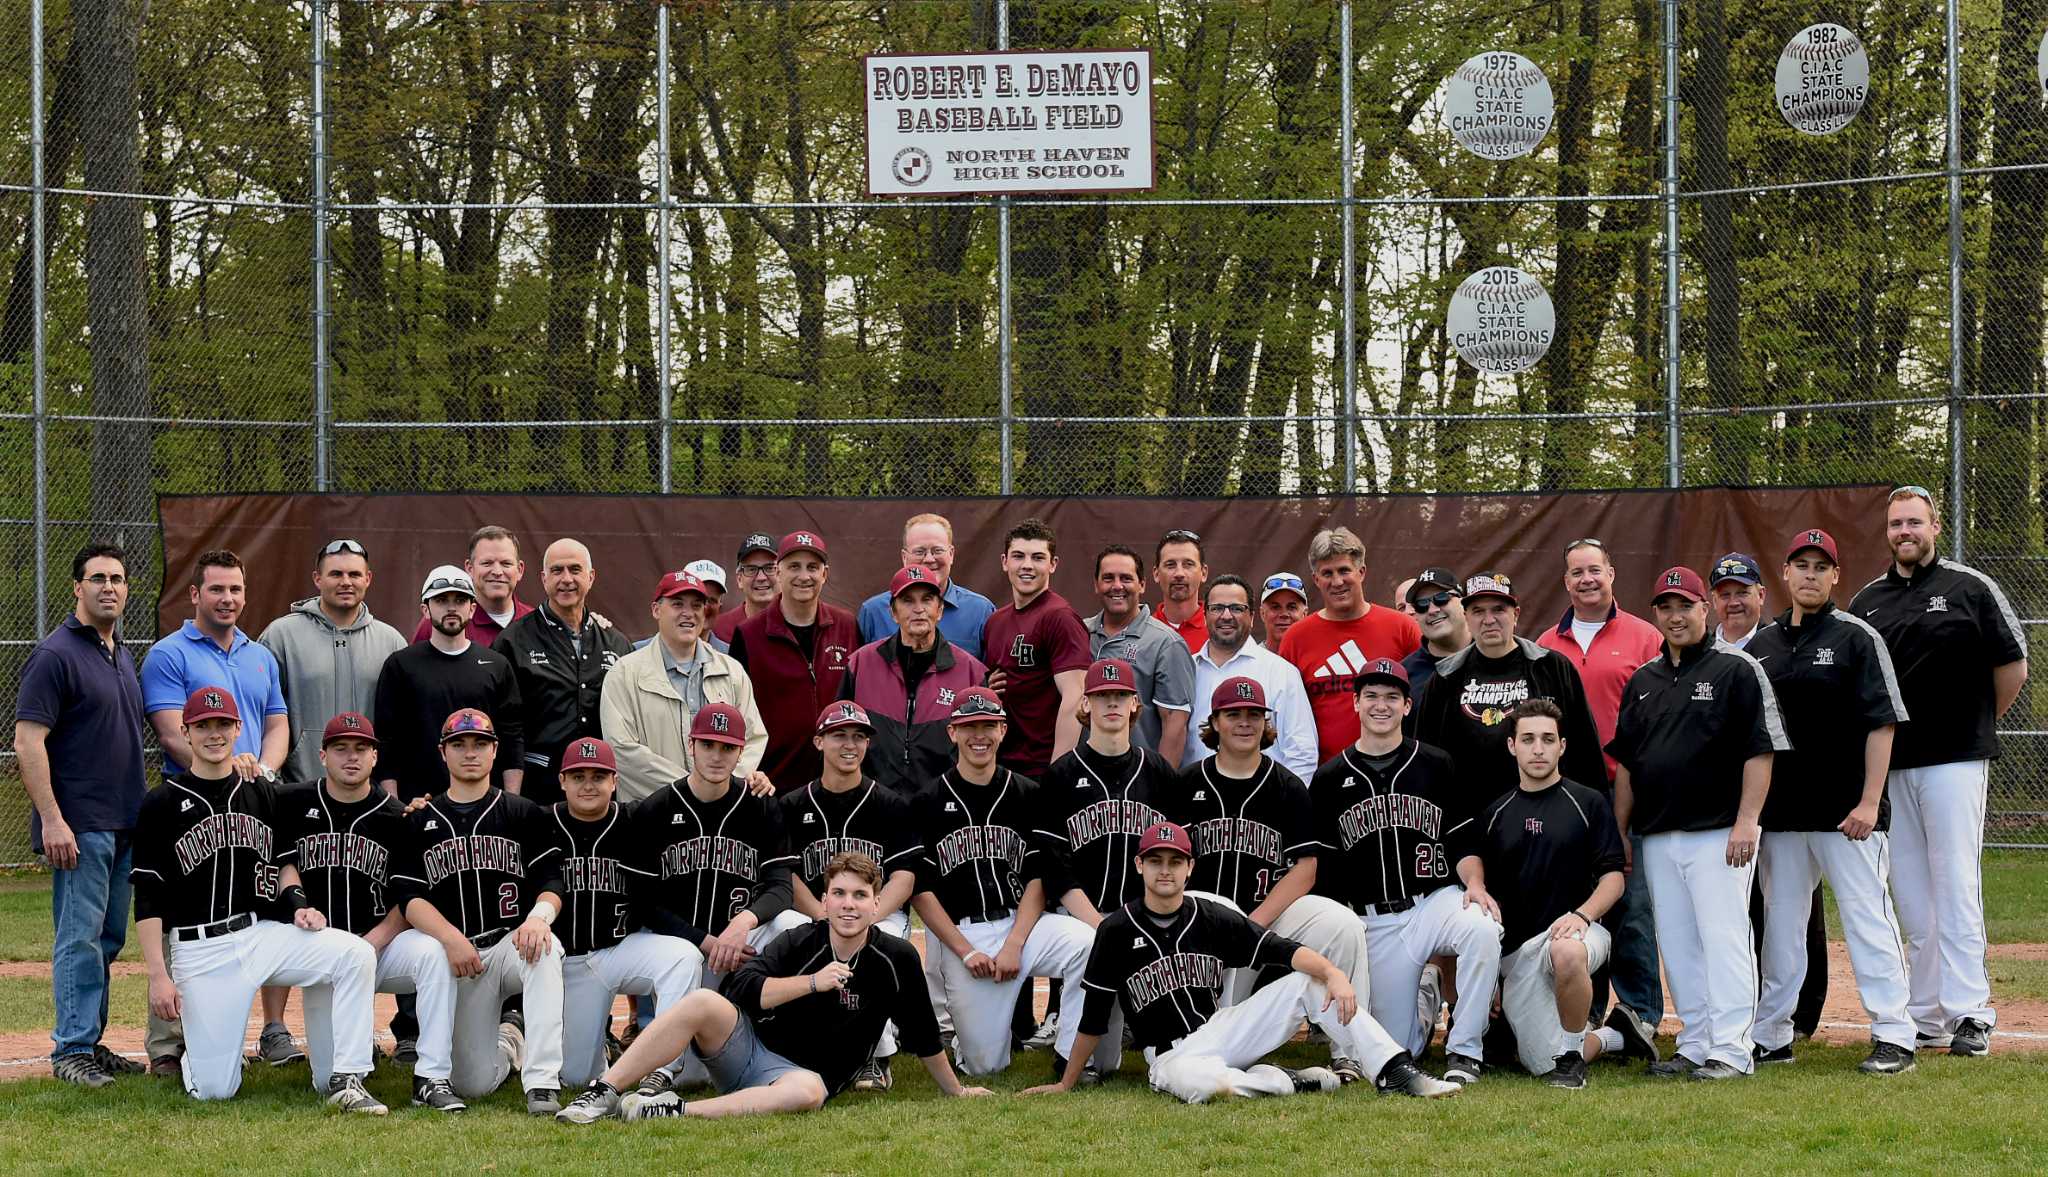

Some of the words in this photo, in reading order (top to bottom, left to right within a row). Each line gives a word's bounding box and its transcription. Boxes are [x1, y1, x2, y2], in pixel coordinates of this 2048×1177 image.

[1808, 27, 1838, 44] 1982
[1483, 55, 1518, 71] 1975
[873, 65, 987, 100] ROBERT
[995, 64, 1020, 98] E.
[1802, 73, 1843, 90] STATE
[1475, 101, 1523, 114] STATE
[1782, 85, 1864, 111] CHAMPIONS
[897, 106, 1038, 133] BASEBALL
[1045, 103, 1124, 130] FIELD
[1452, 114, 1547, 132] CHAMPIONS
[1800, 119, 1832, 133] CLASS
[1834, 116, 1846, 128] LL
[946, 149, 1037, 164] NORTH
[1043, 147, 1131, 162] HAVEN
[1473, 143, 1510, 157] CLASS
[1512, 143, 1525, 154] LL
[953, 166, 1021, 181] HIGH
[1026, 164, 1125, 180] SCHOOL
[1481, 269, 1519, 286] 2015
[1478, 316, 1525, 330] STATE
[1455, 330, 1550, 349] CHAMPIONS
[1478, 358, 1519, 373] CLASS
[1522, 358, 1529, 368] L
[1480, 682, 1516, 692] STANLEY
[1066, 800, 1120, 852] NORTH
[1122, 800, 1167, 836] HAV
[1339, 795, 1388, 852] NORTH
[1388, 793, 1443, 841] HAVEN
[175, 813, 225, 876] NORTH
[226, 812, 274, 863] HAVEN
[936, 826, 984, 876] NORTH
[1191, 818, 1233, 858] ORTH
[1234, 818, 1282, 866] HAVE
[295, 833, 341, 873] ORTH
[343, 833, 389, 887] HAVE
[424, 836, 469, 890] ORTH
[661, 836, 711, 881] NORTH
[1415, 843, 1449, 878] 26
[254, 861, 279, 902] 25
[498, 882, 520, 919] 2
[1126, 955, 1179, 1013] NORTH
